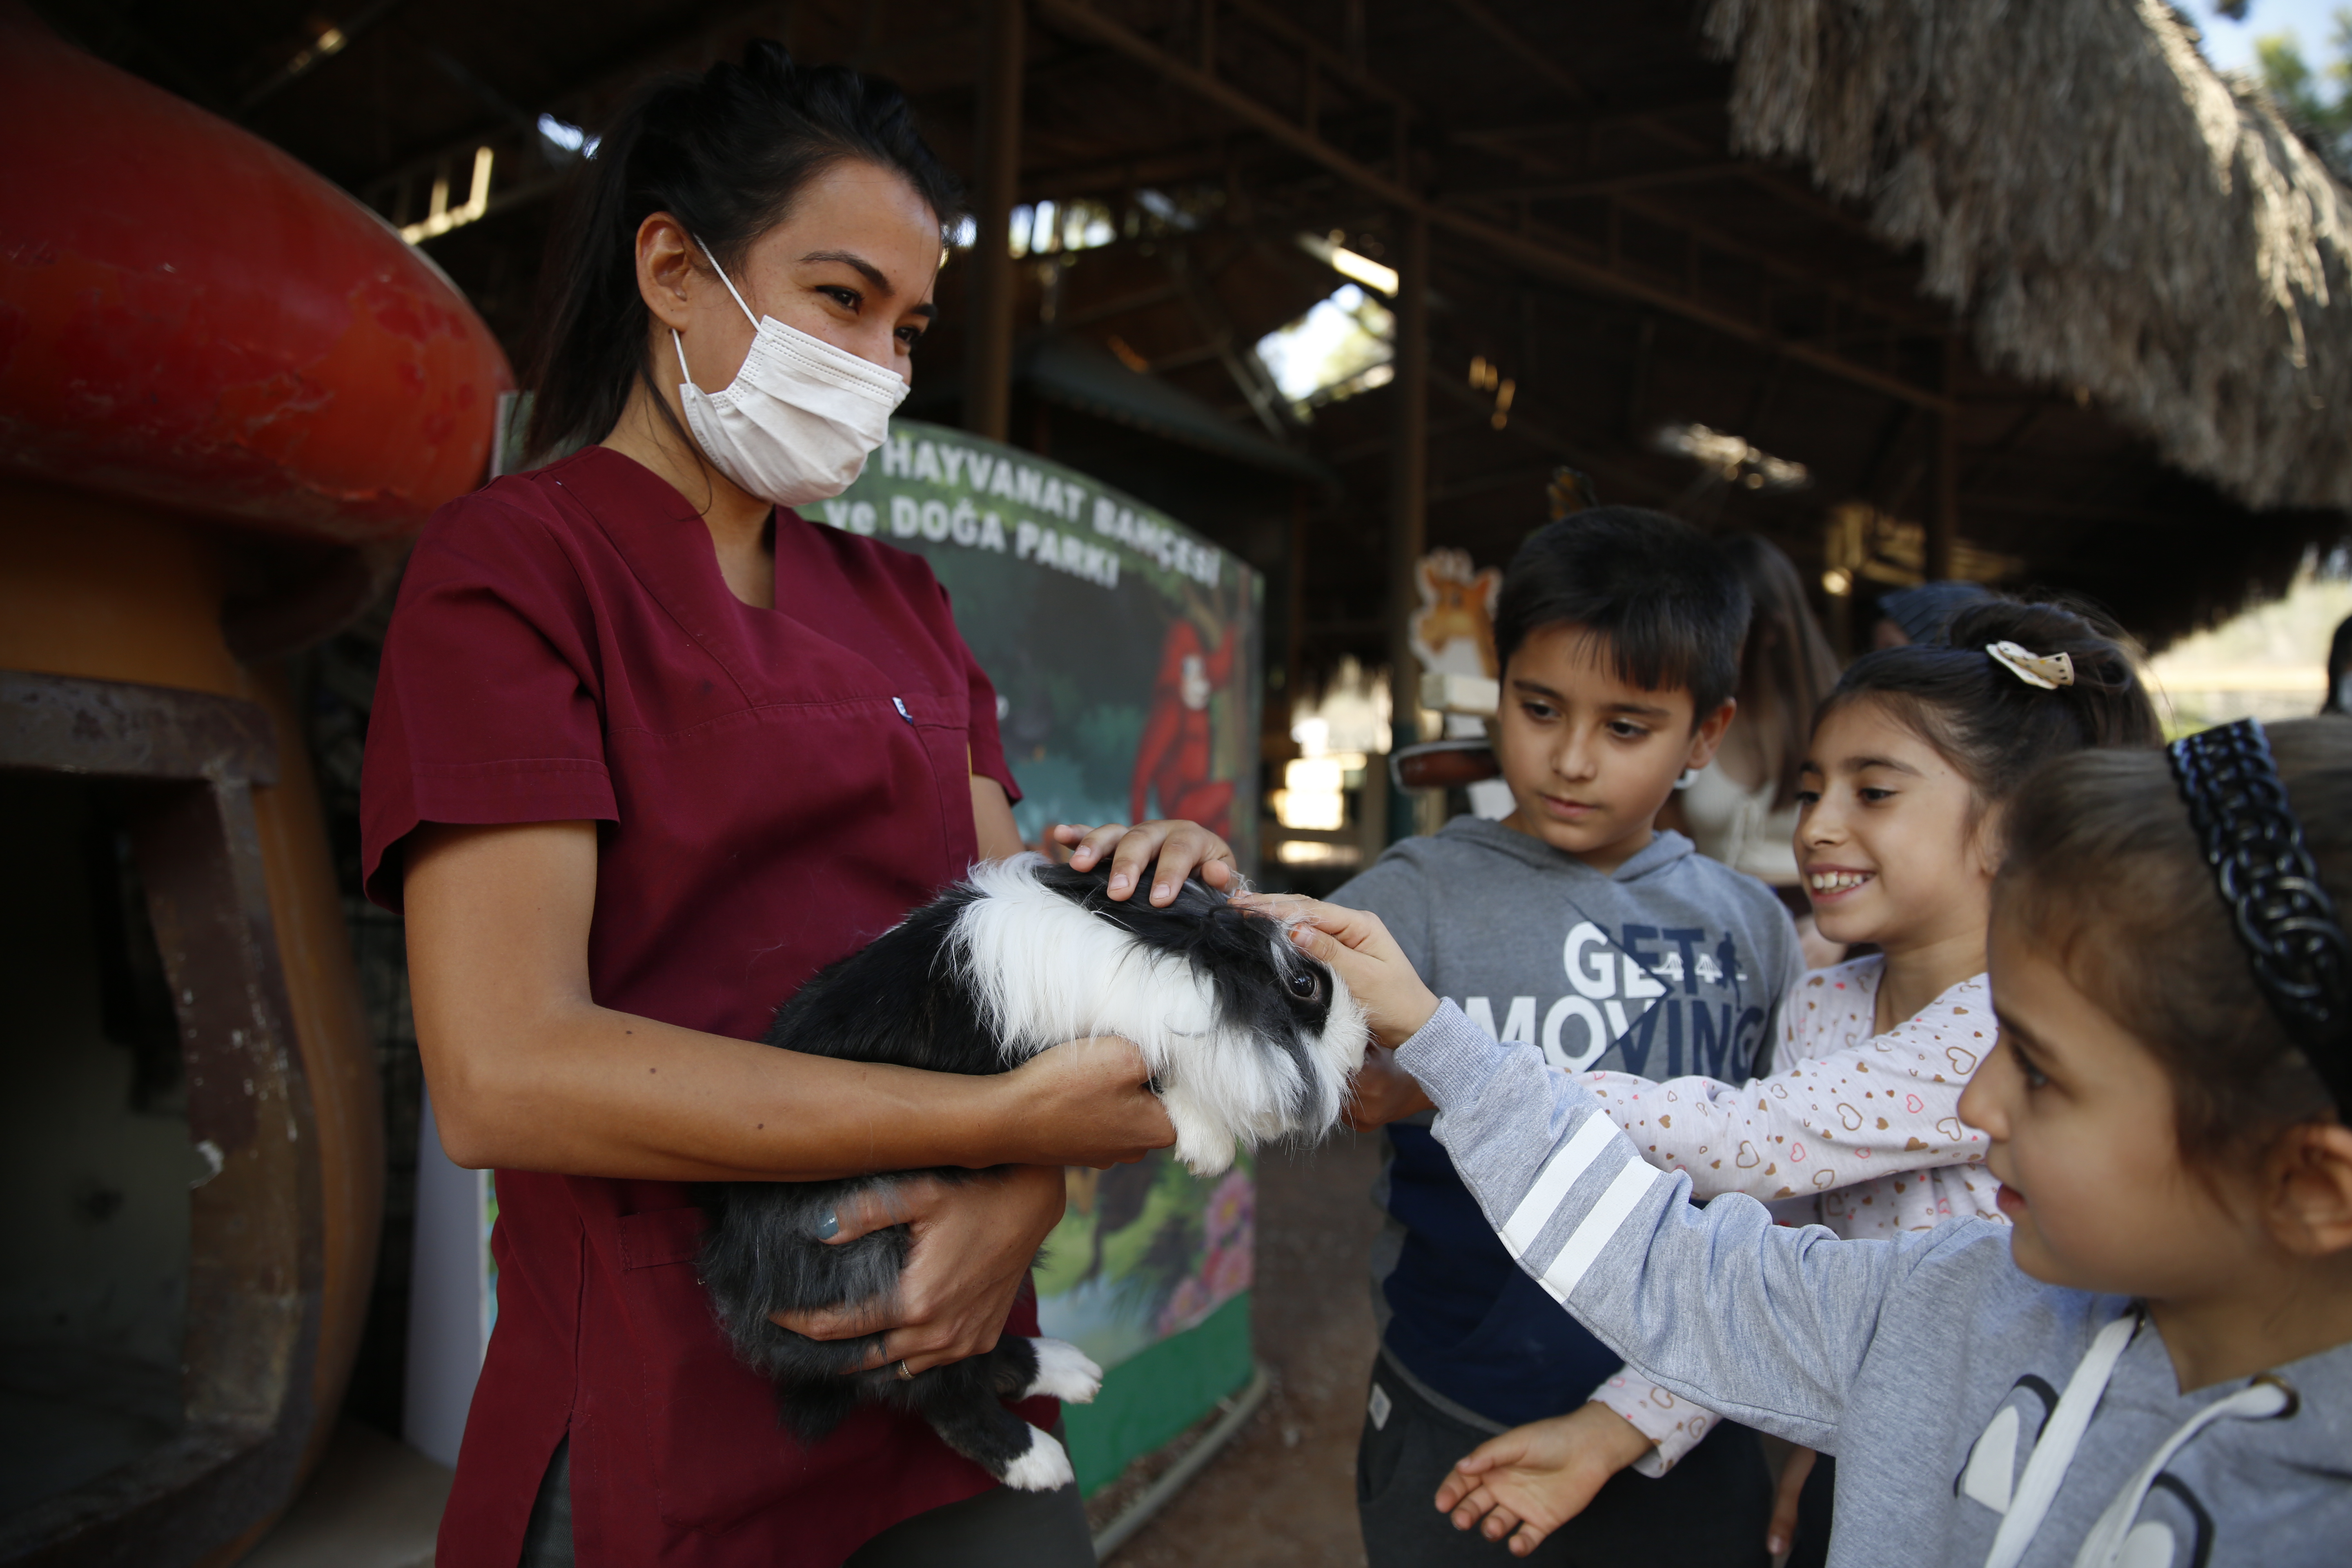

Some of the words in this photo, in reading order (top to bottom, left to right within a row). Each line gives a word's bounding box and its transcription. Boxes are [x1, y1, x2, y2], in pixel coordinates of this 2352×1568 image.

[881, 434, 1086, 523] HAYVANAT
[889, 494, 1007, 554] DOĞA
[1564, 921, 1705, 999] GET
[1465, 995, 1765, 1083] MOVING
